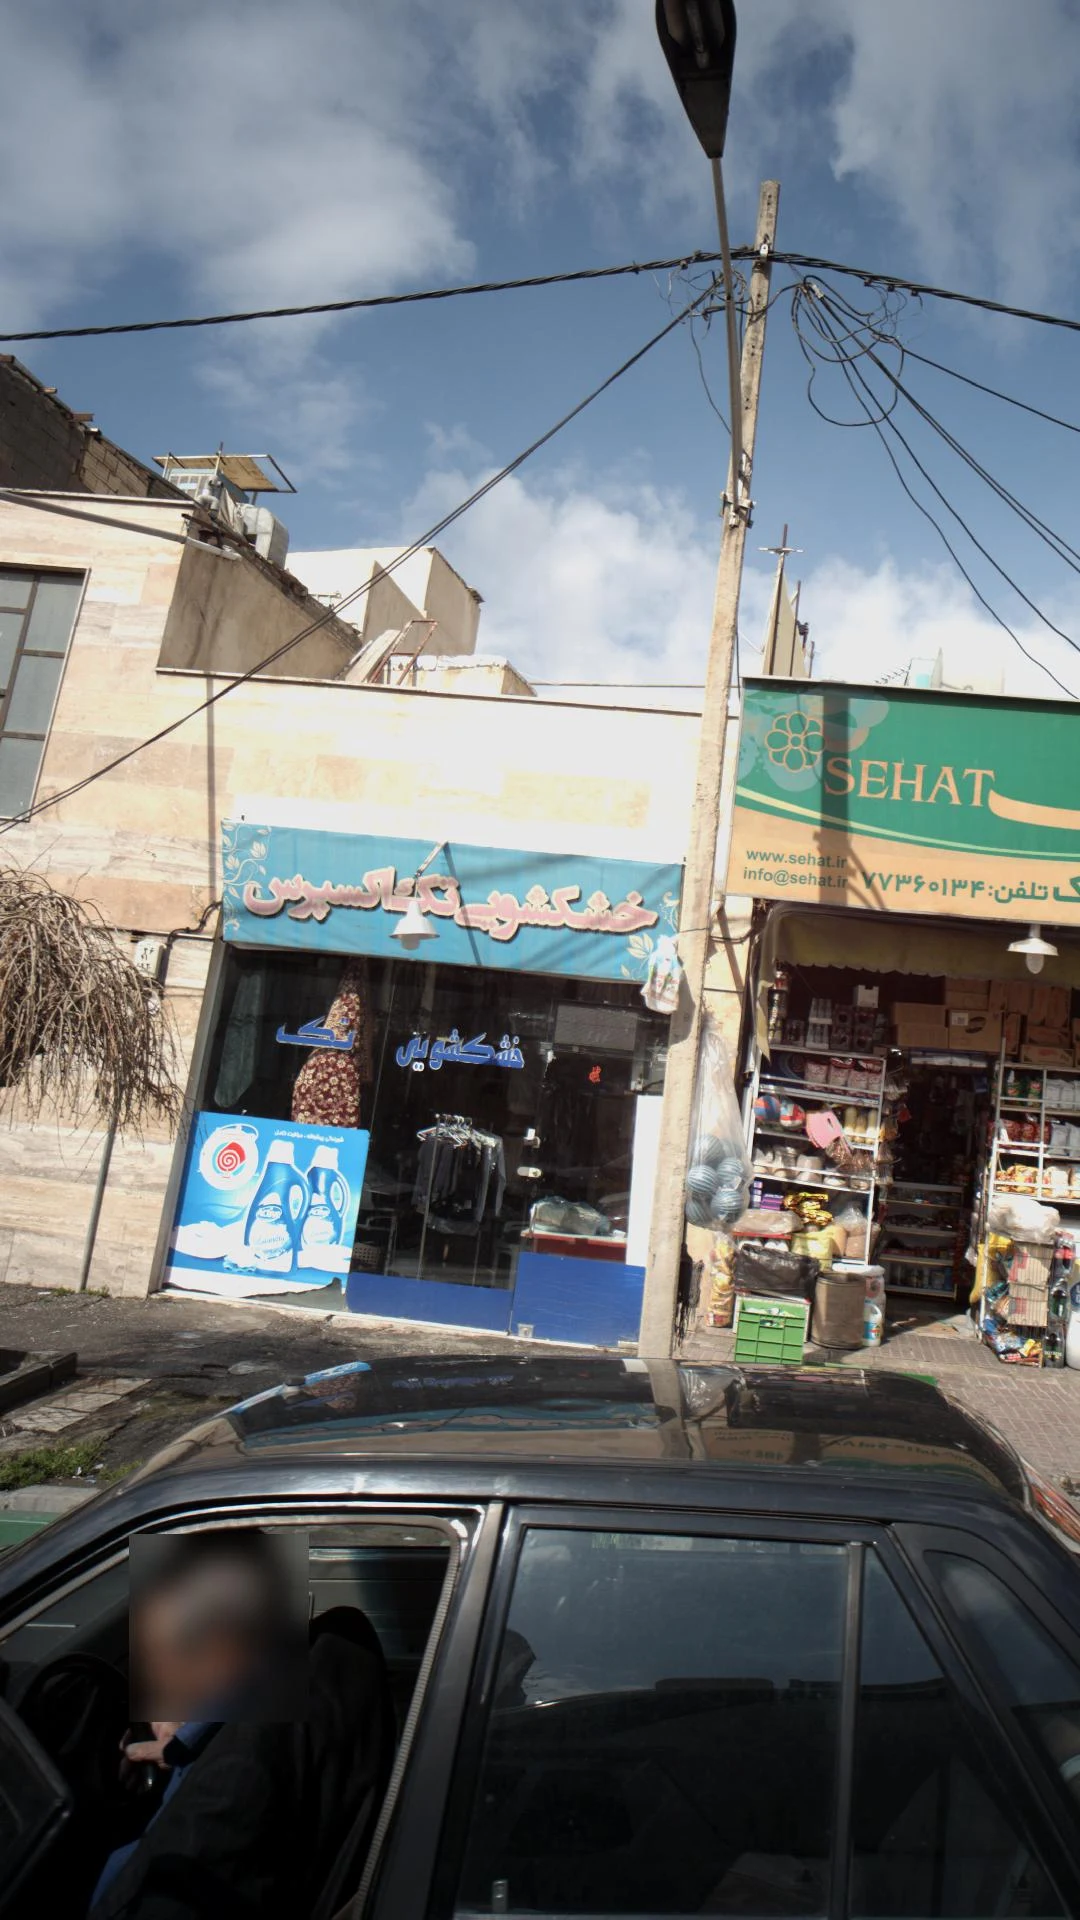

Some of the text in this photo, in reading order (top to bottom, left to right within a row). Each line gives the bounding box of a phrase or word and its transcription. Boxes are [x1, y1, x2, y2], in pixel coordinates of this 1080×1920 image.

[824, 756, 996, 808] SEHAT
[743, 867, 849, 889] info@sehat.ir
[746, 850, 848, 869] www.sehat.ir
[243, 865, 397, 922] اکسپرس
[454, 884, 659, 942] خشکشویی
[276, 1015, 525, 1072] خشکشویی تک
